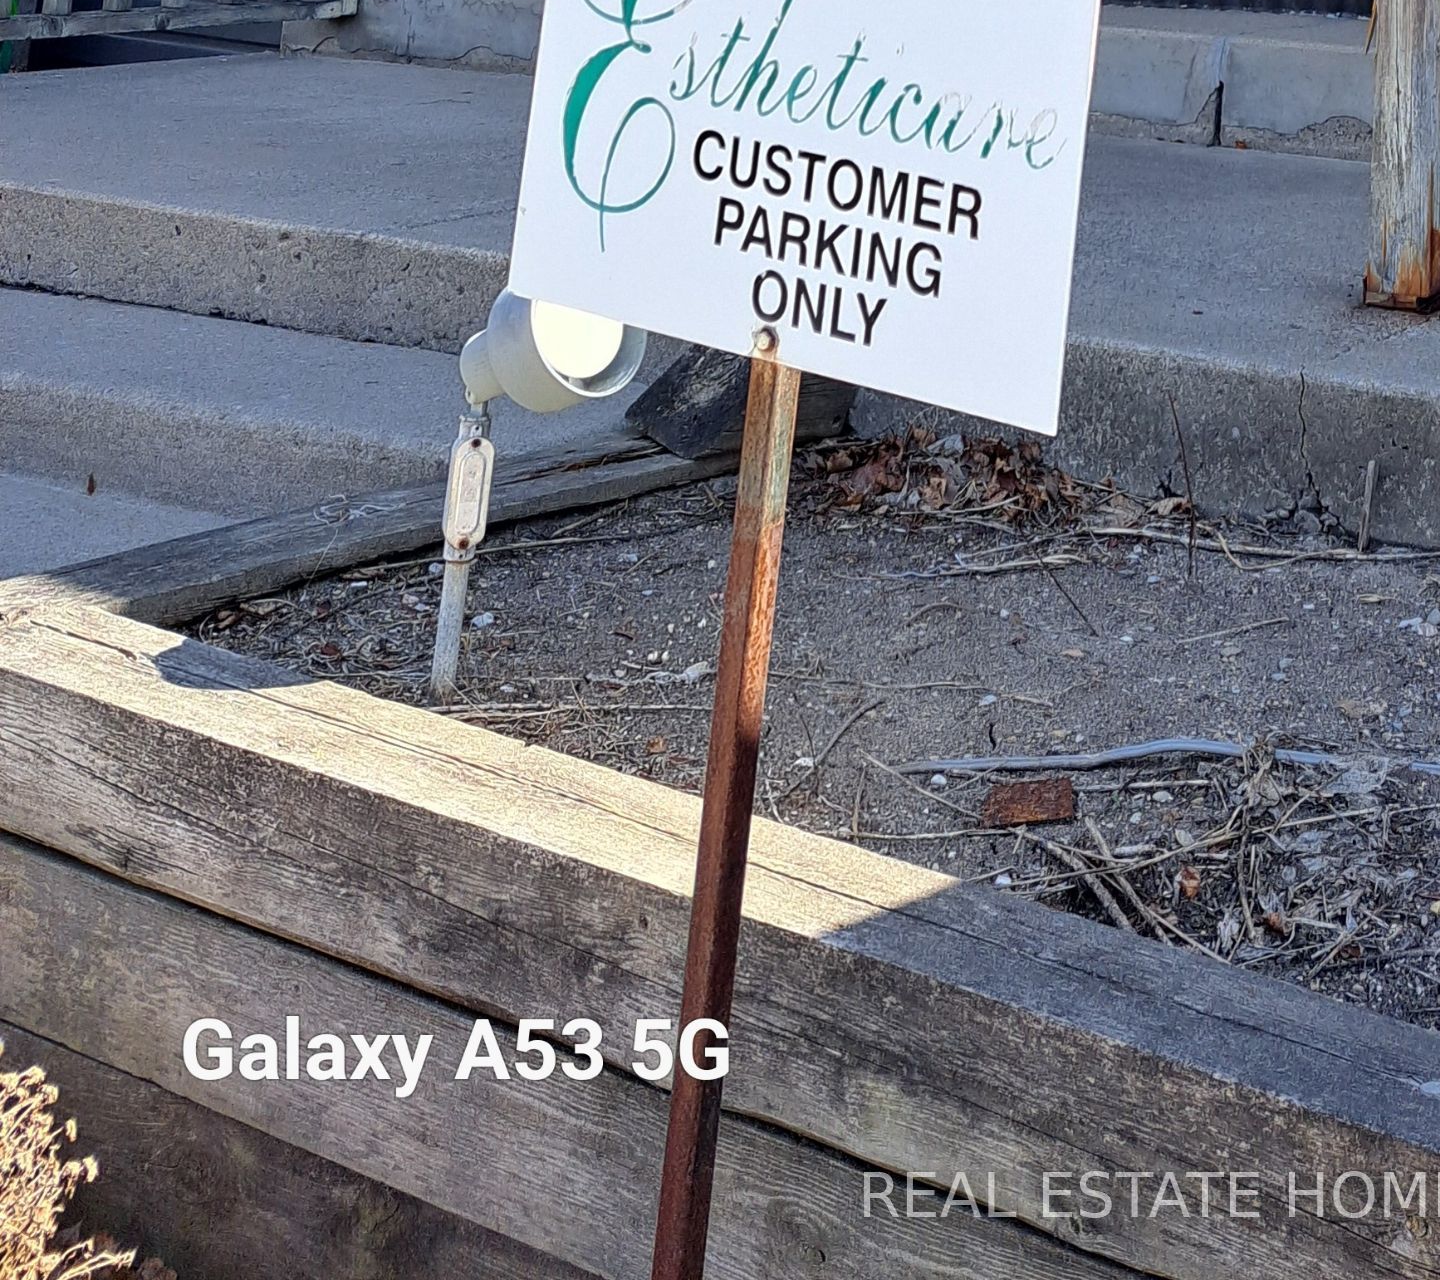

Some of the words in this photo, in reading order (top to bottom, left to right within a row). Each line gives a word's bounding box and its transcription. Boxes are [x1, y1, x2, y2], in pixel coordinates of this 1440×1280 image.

[692, 129, 983, 240] CUSTOMER
[713, 197, 943, 298] PARKING
[752, 269, 887, 347] ONLY
